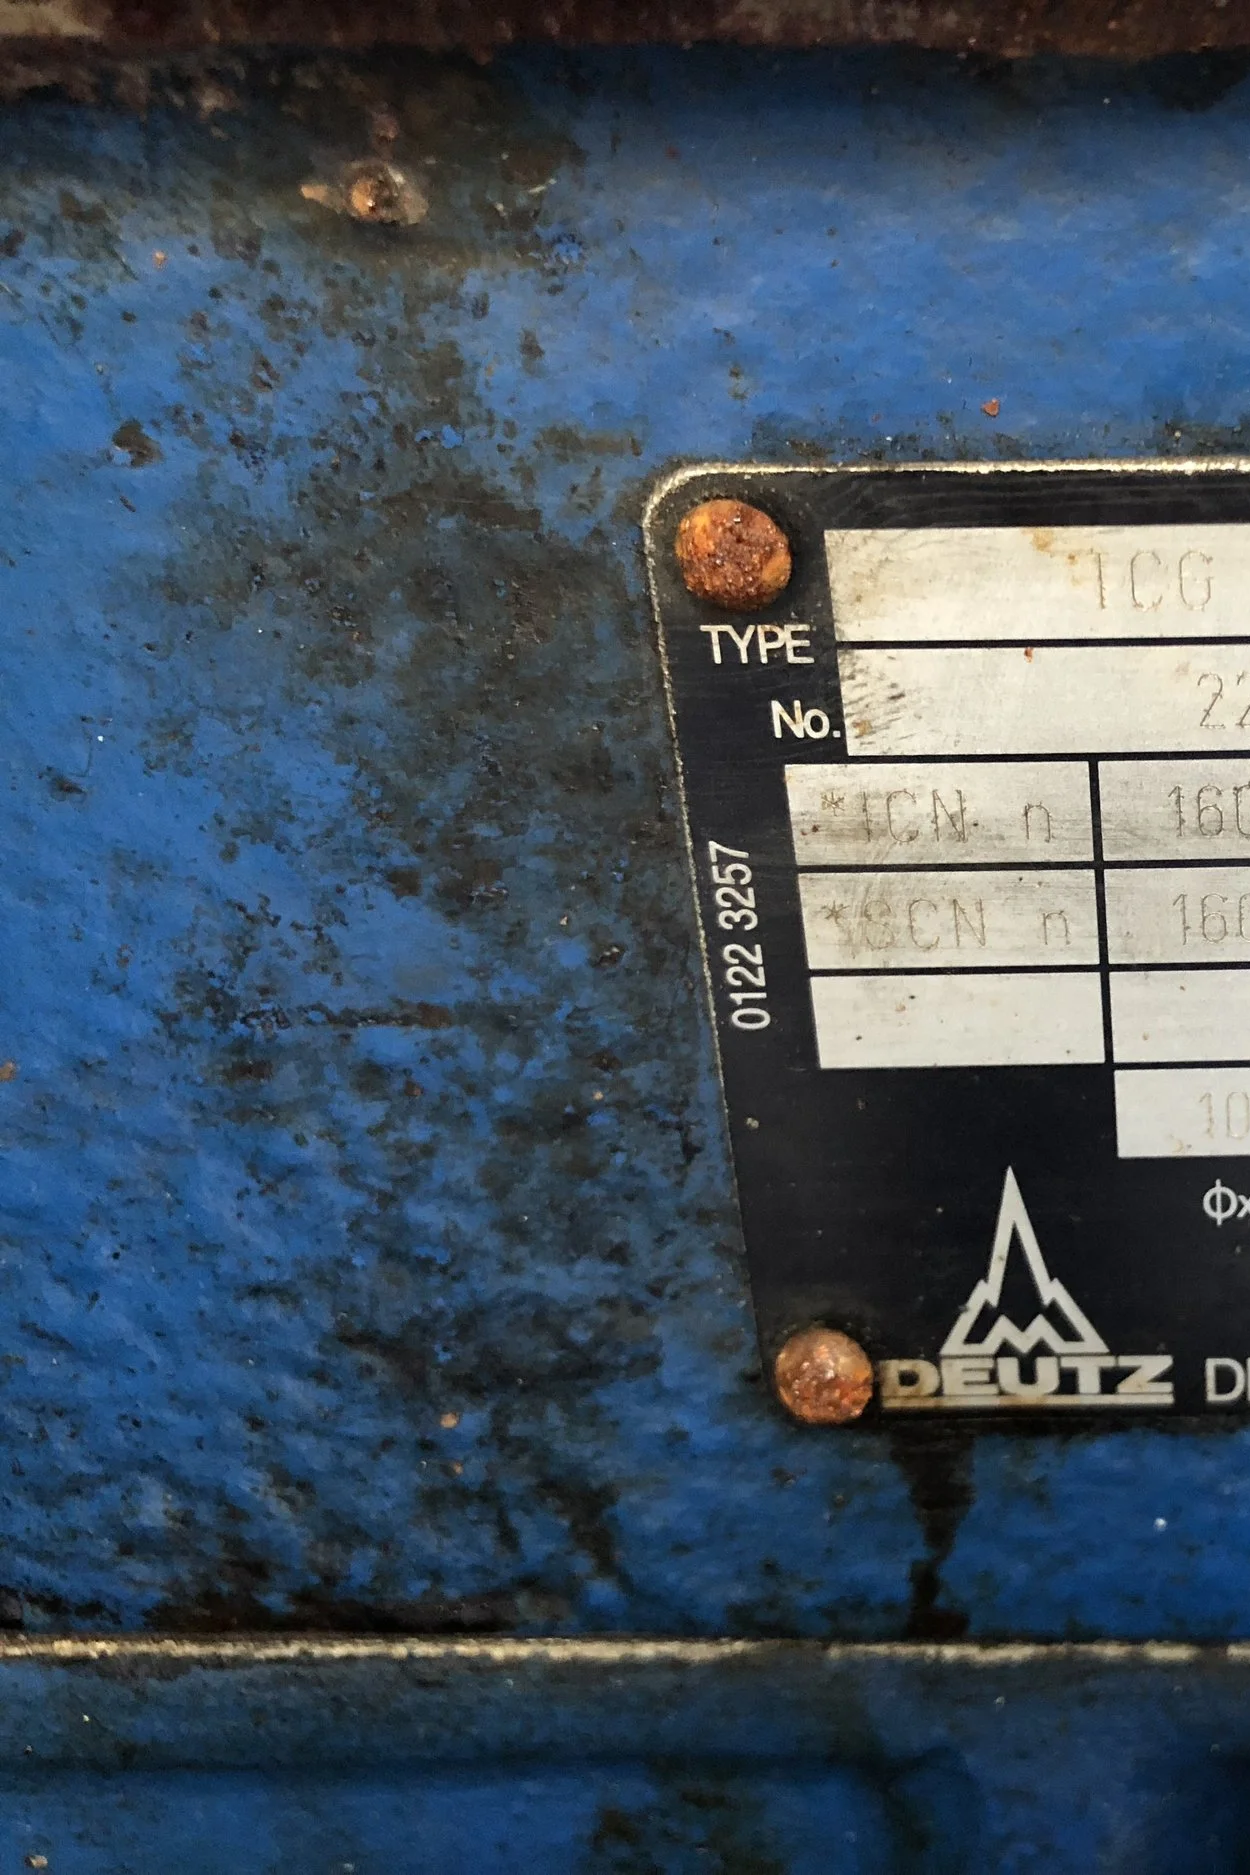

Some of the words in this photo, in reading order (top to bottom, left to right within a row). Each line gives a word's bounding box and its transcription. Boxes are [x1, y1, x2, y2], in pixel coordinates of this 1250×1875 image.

[700, 624, 815, 664] TYPE
[771, 699, 841, 739] No.
[708, 840, 758, 931] 3257
[731, 943, 771, 1031] 0122
[878, 1354, 1176, 1397] DEUTZ
